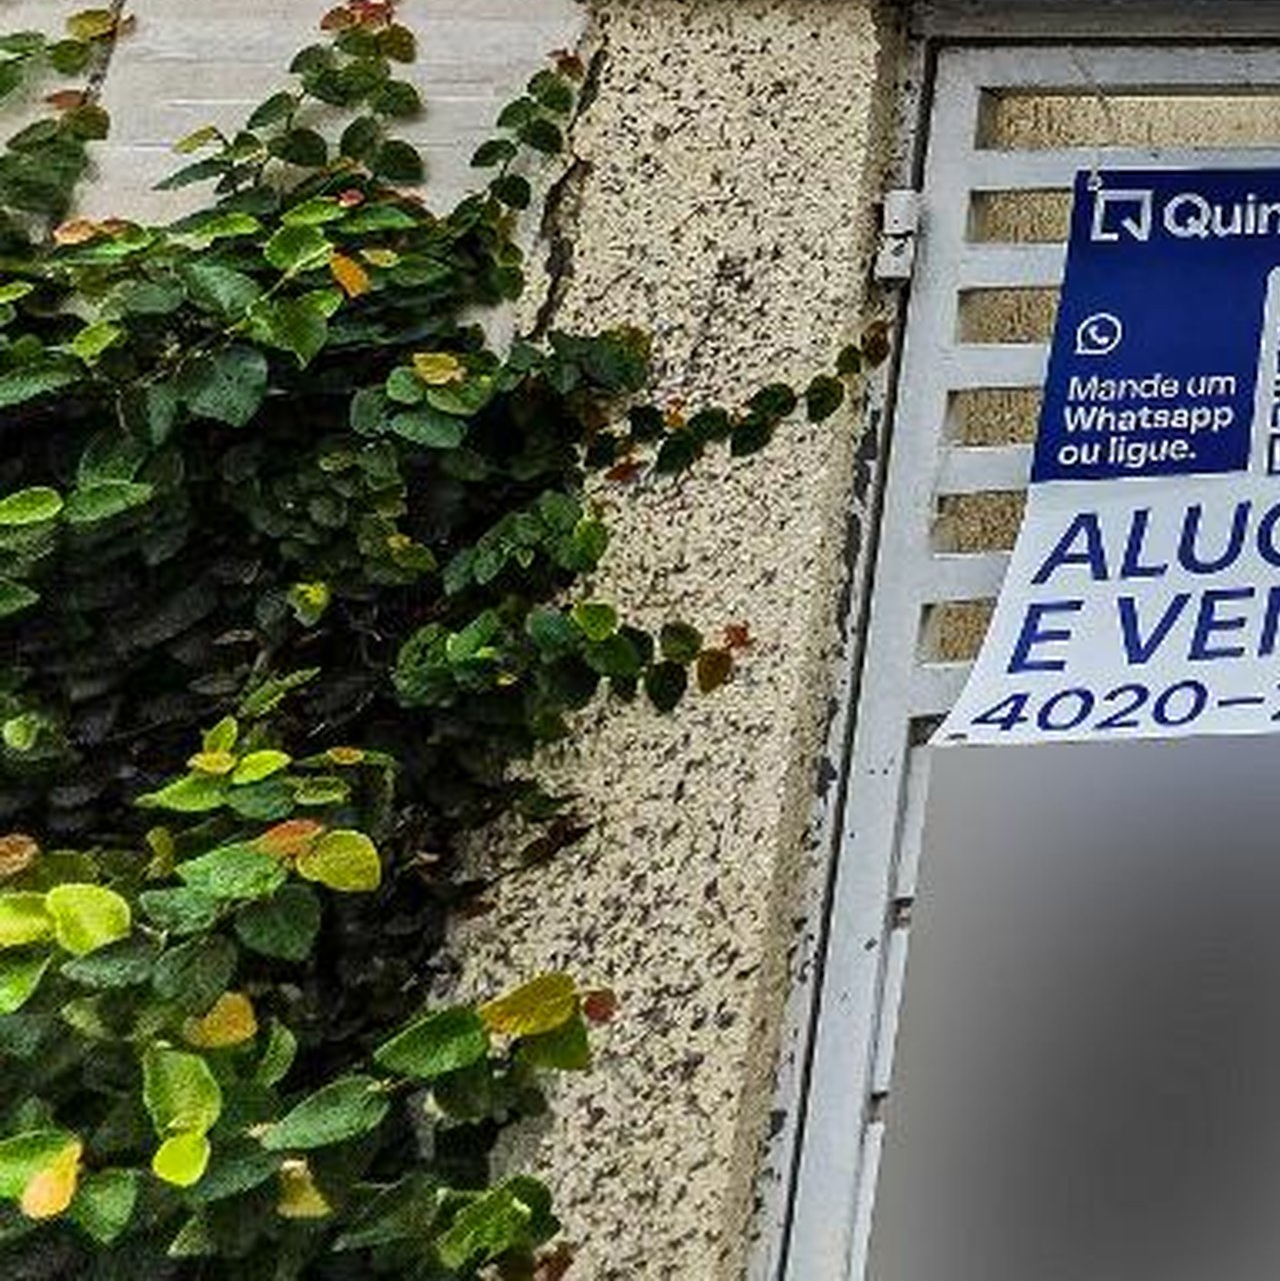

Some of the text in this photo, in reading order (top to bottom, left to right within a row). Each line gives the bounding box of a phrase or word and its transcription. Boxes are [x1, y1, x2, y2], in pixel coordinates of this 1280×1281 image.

[1067, 373, 1236, 401] Mande um
[1064, 404, 1235, 435] Whatsapp
[1057, 436, 1197, 468] ou ligue.
[1007, 599, 1085, 675] E
